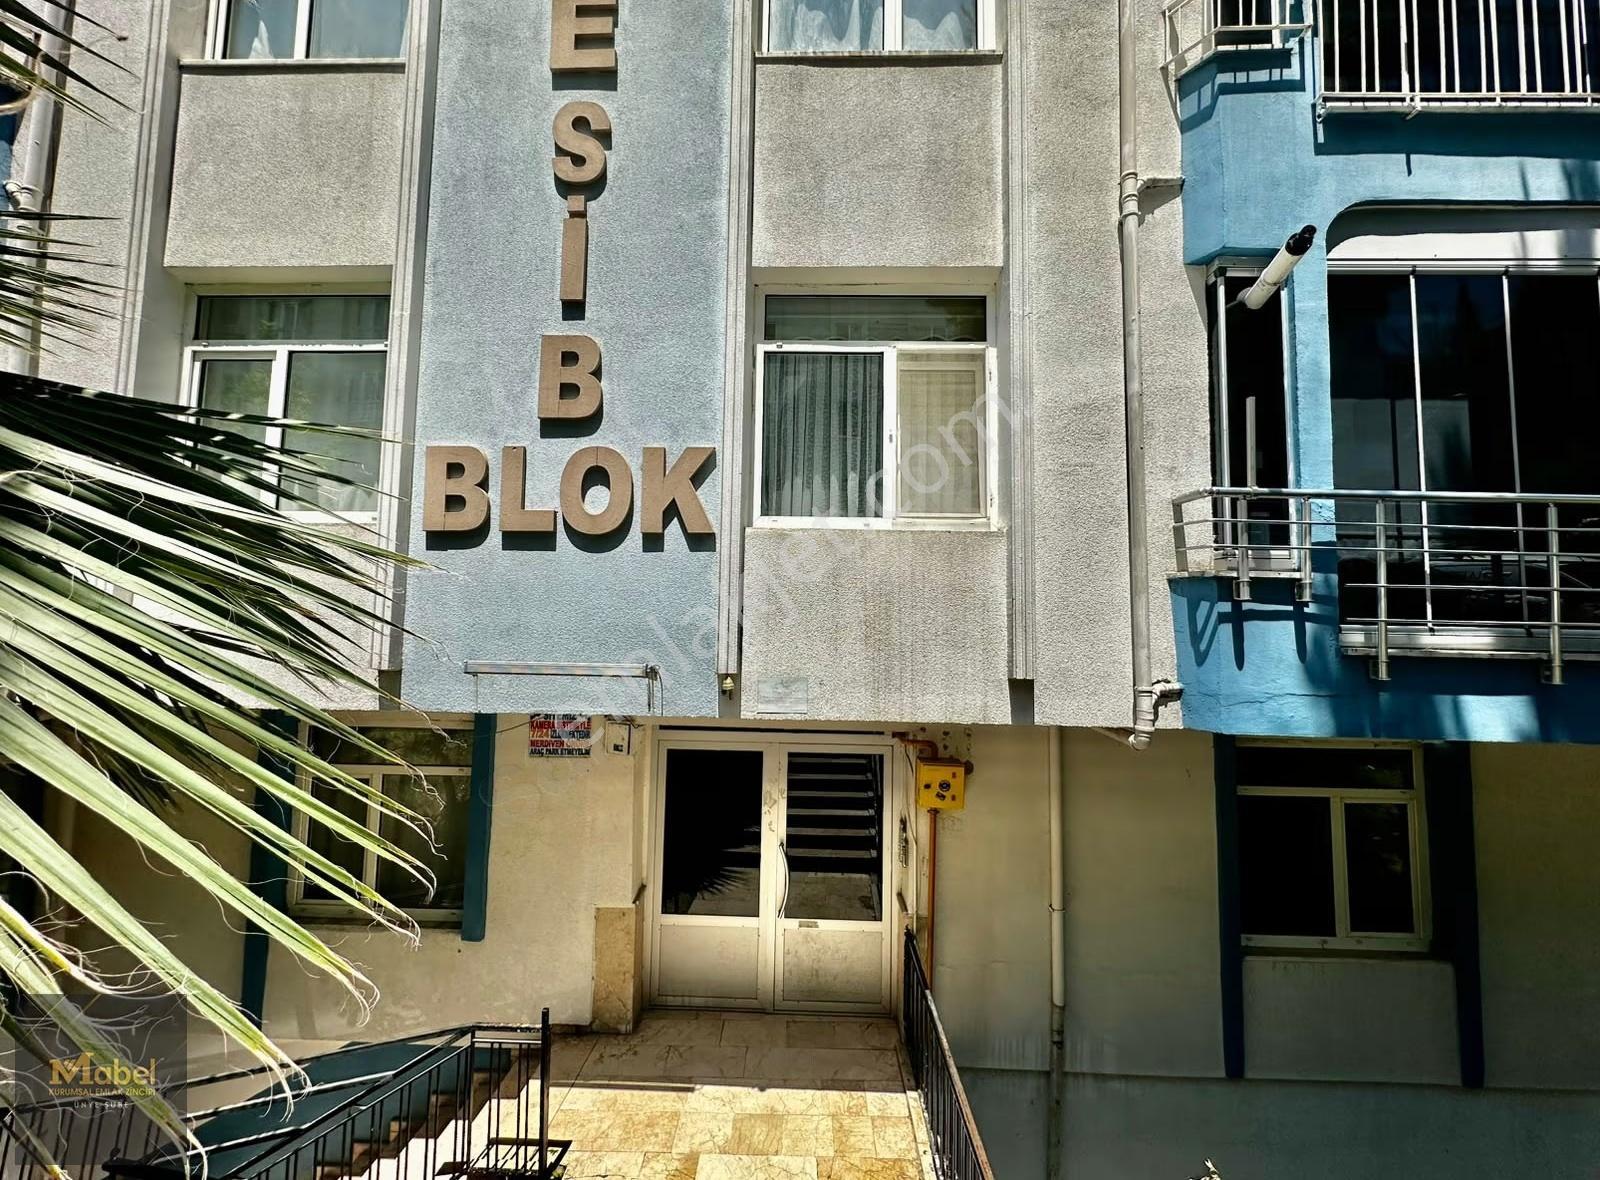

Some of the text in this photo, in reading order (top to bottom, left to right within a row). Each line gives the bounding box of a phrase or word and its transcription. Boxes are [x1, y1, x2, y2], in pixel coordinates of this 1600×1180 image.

[422, 445, 716, 535] BLOK
[530, 720, 555, 729] KAMERA
[529, 748, 544, 756] ARAÇ
